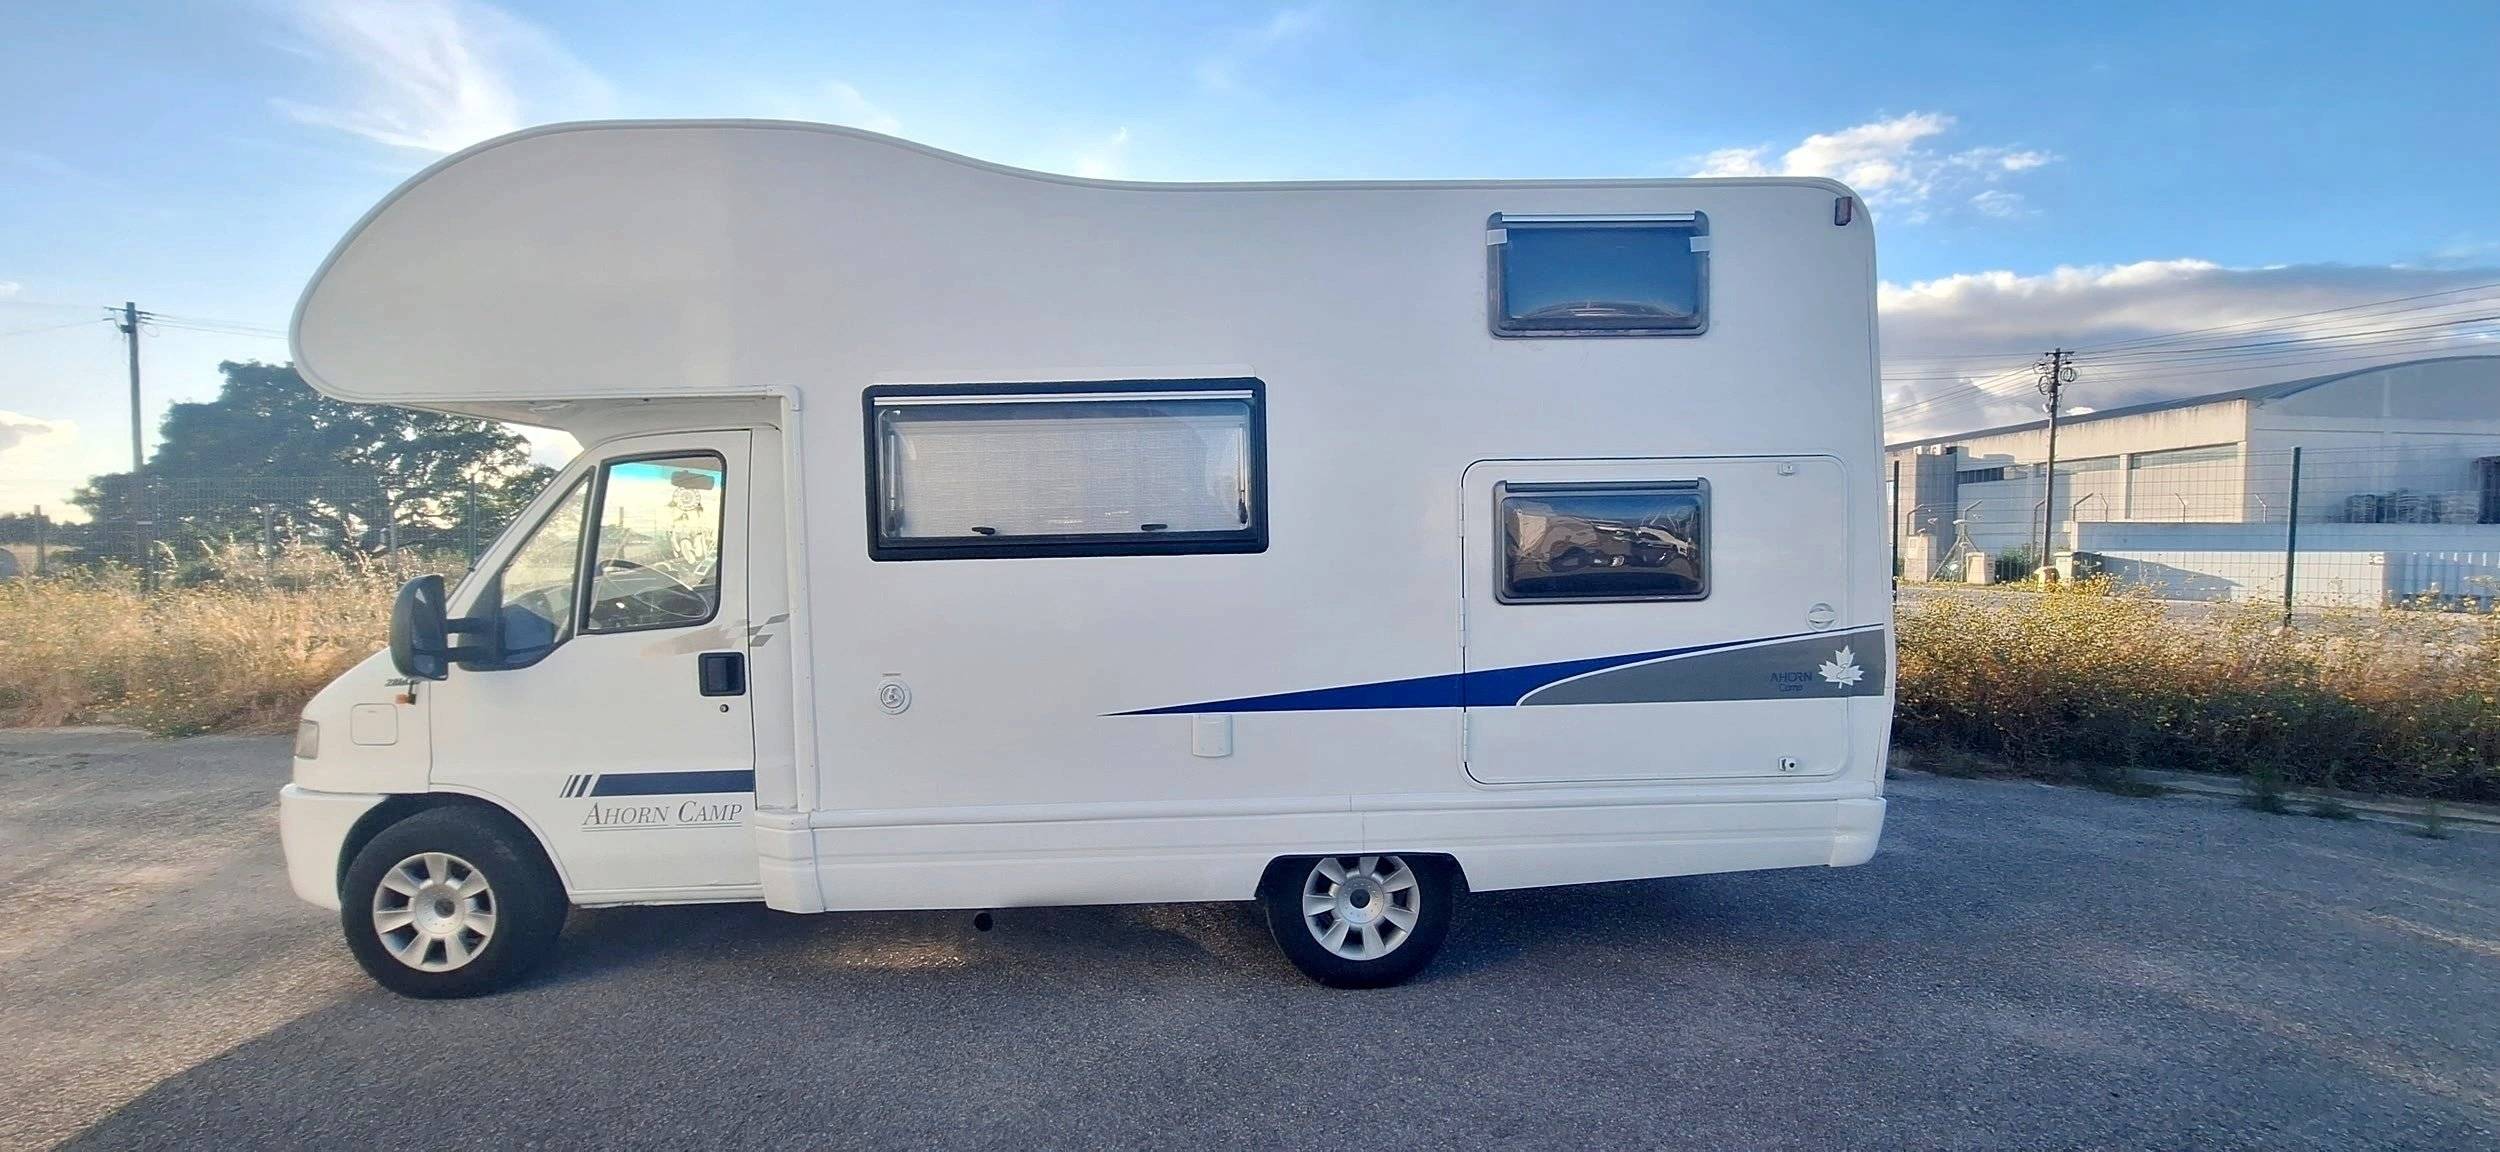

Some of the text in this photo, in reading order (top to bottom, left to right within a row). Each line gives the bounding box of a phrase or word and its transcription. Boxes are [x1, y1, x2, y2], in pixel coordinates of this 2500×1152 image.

[1770, 671, 1812, 682] AHORN
[583, 800, 743, 825] AHORN CAMP
